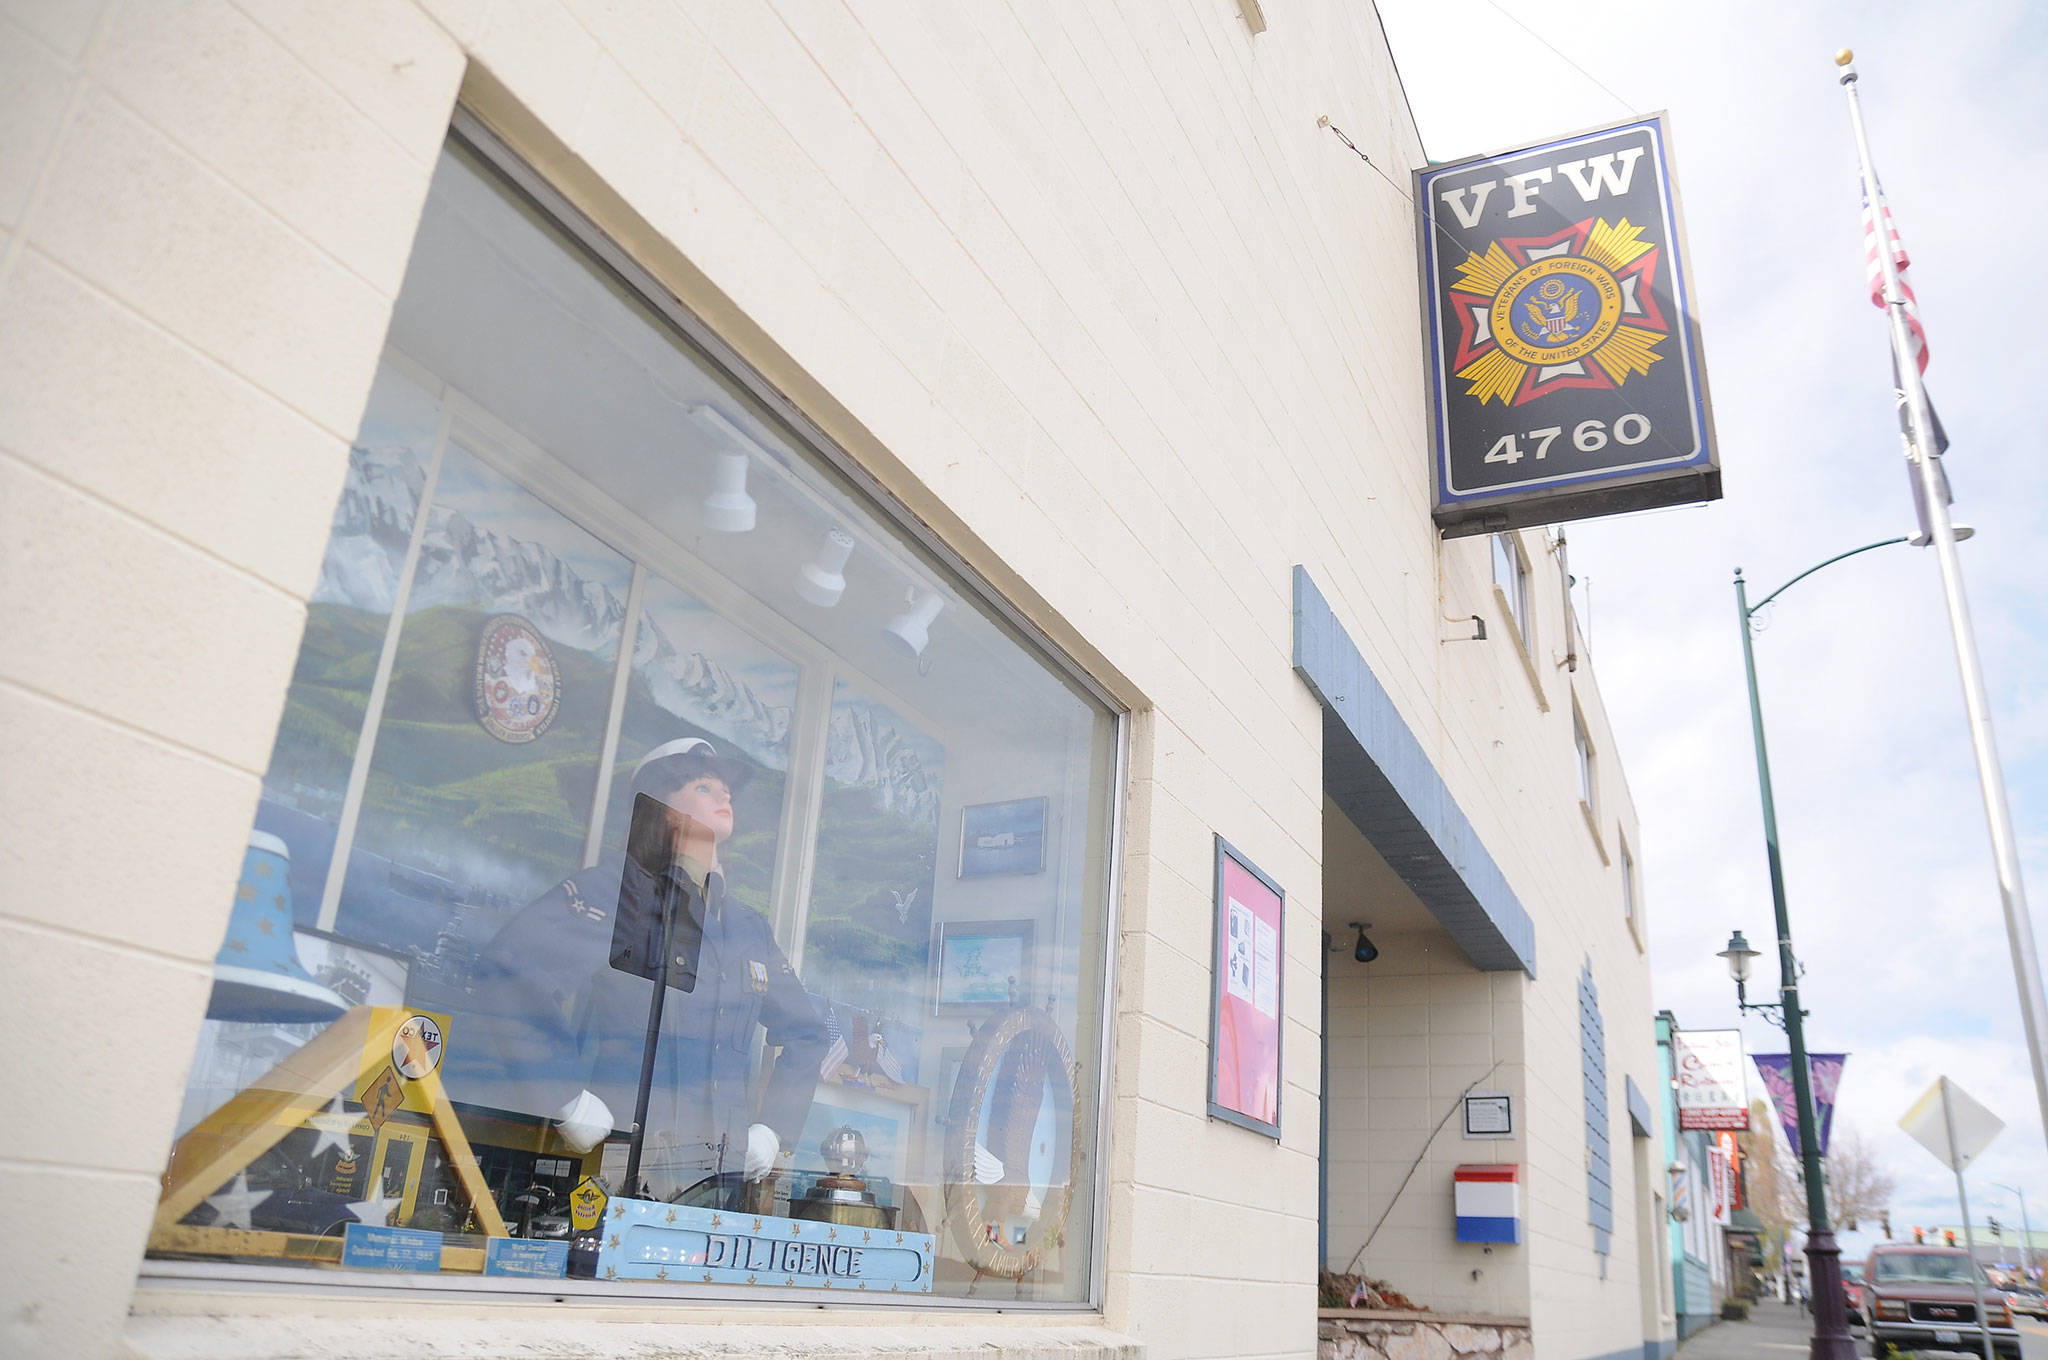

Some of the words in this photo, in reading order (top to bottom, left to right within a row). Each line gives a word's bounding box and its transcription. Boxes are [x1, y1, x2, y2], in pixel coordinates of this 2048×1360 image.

[1440, 146, 1645, 230] VFW
[1496, 275, 1527, 322] VETERANS
[1530, 265, 1543, 276] OF
[1548, 261, 1594, 276] FOREIGN
[1596, 273, 1616, 300] WARS
[1505, 337, 1518, 348] OF
[1518, 347, 1538, 359] THE
[1541, 347, 1580, 360] UNITED
[1582, 320, 1611, 349] STATES
[1483, 413, 1652, 465] 4760
[704, 1234, 865, 1277] DILIGENCE
